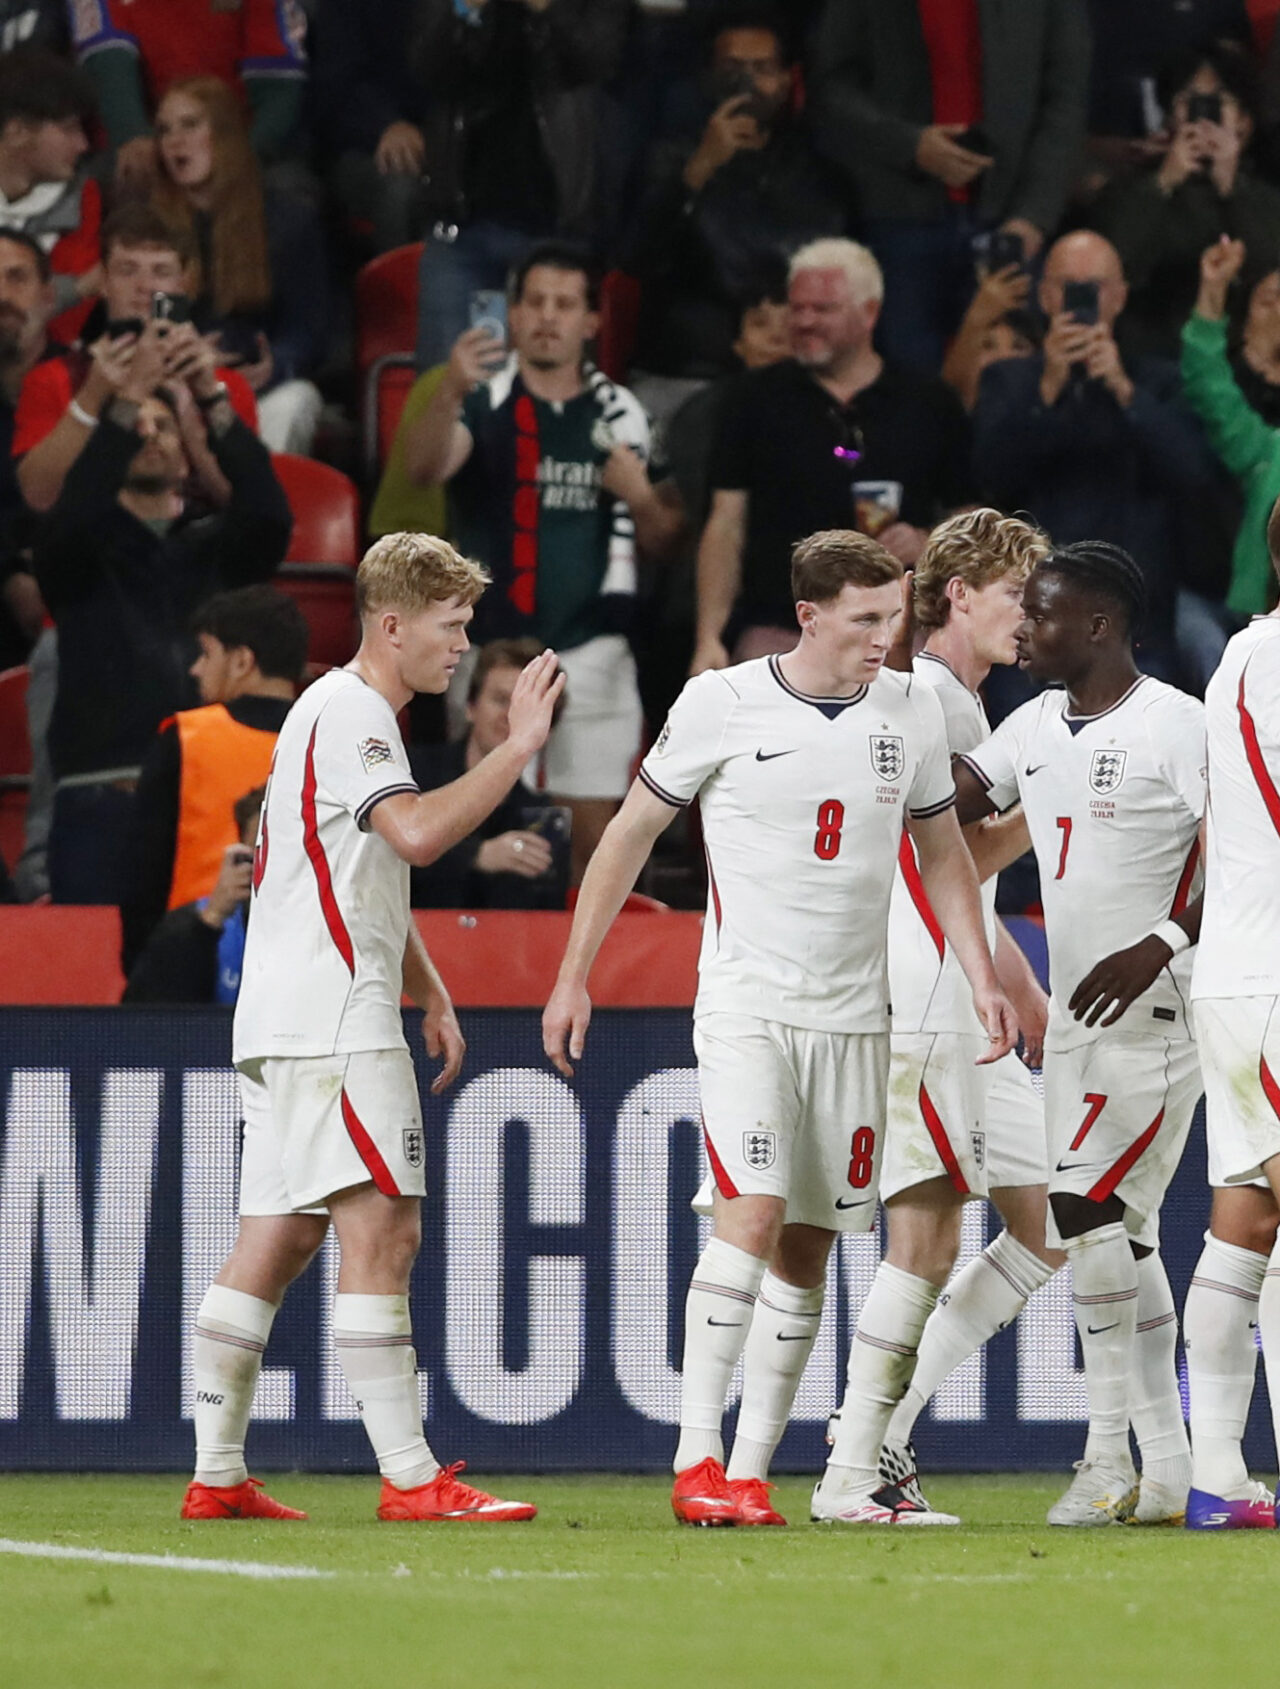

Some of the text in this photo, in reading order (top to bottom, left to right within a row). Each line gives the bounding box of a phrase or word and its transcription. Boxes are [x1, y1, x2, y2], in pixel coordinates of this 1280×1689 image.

[814, 799, 845, 860] 8
[1054, 817, 1072, 880] 7
[1069, 1092, 1108, 1151] 7
[847, 1126, 875, 1189] 8
[0, 1066, 1095, 1424] WECO
